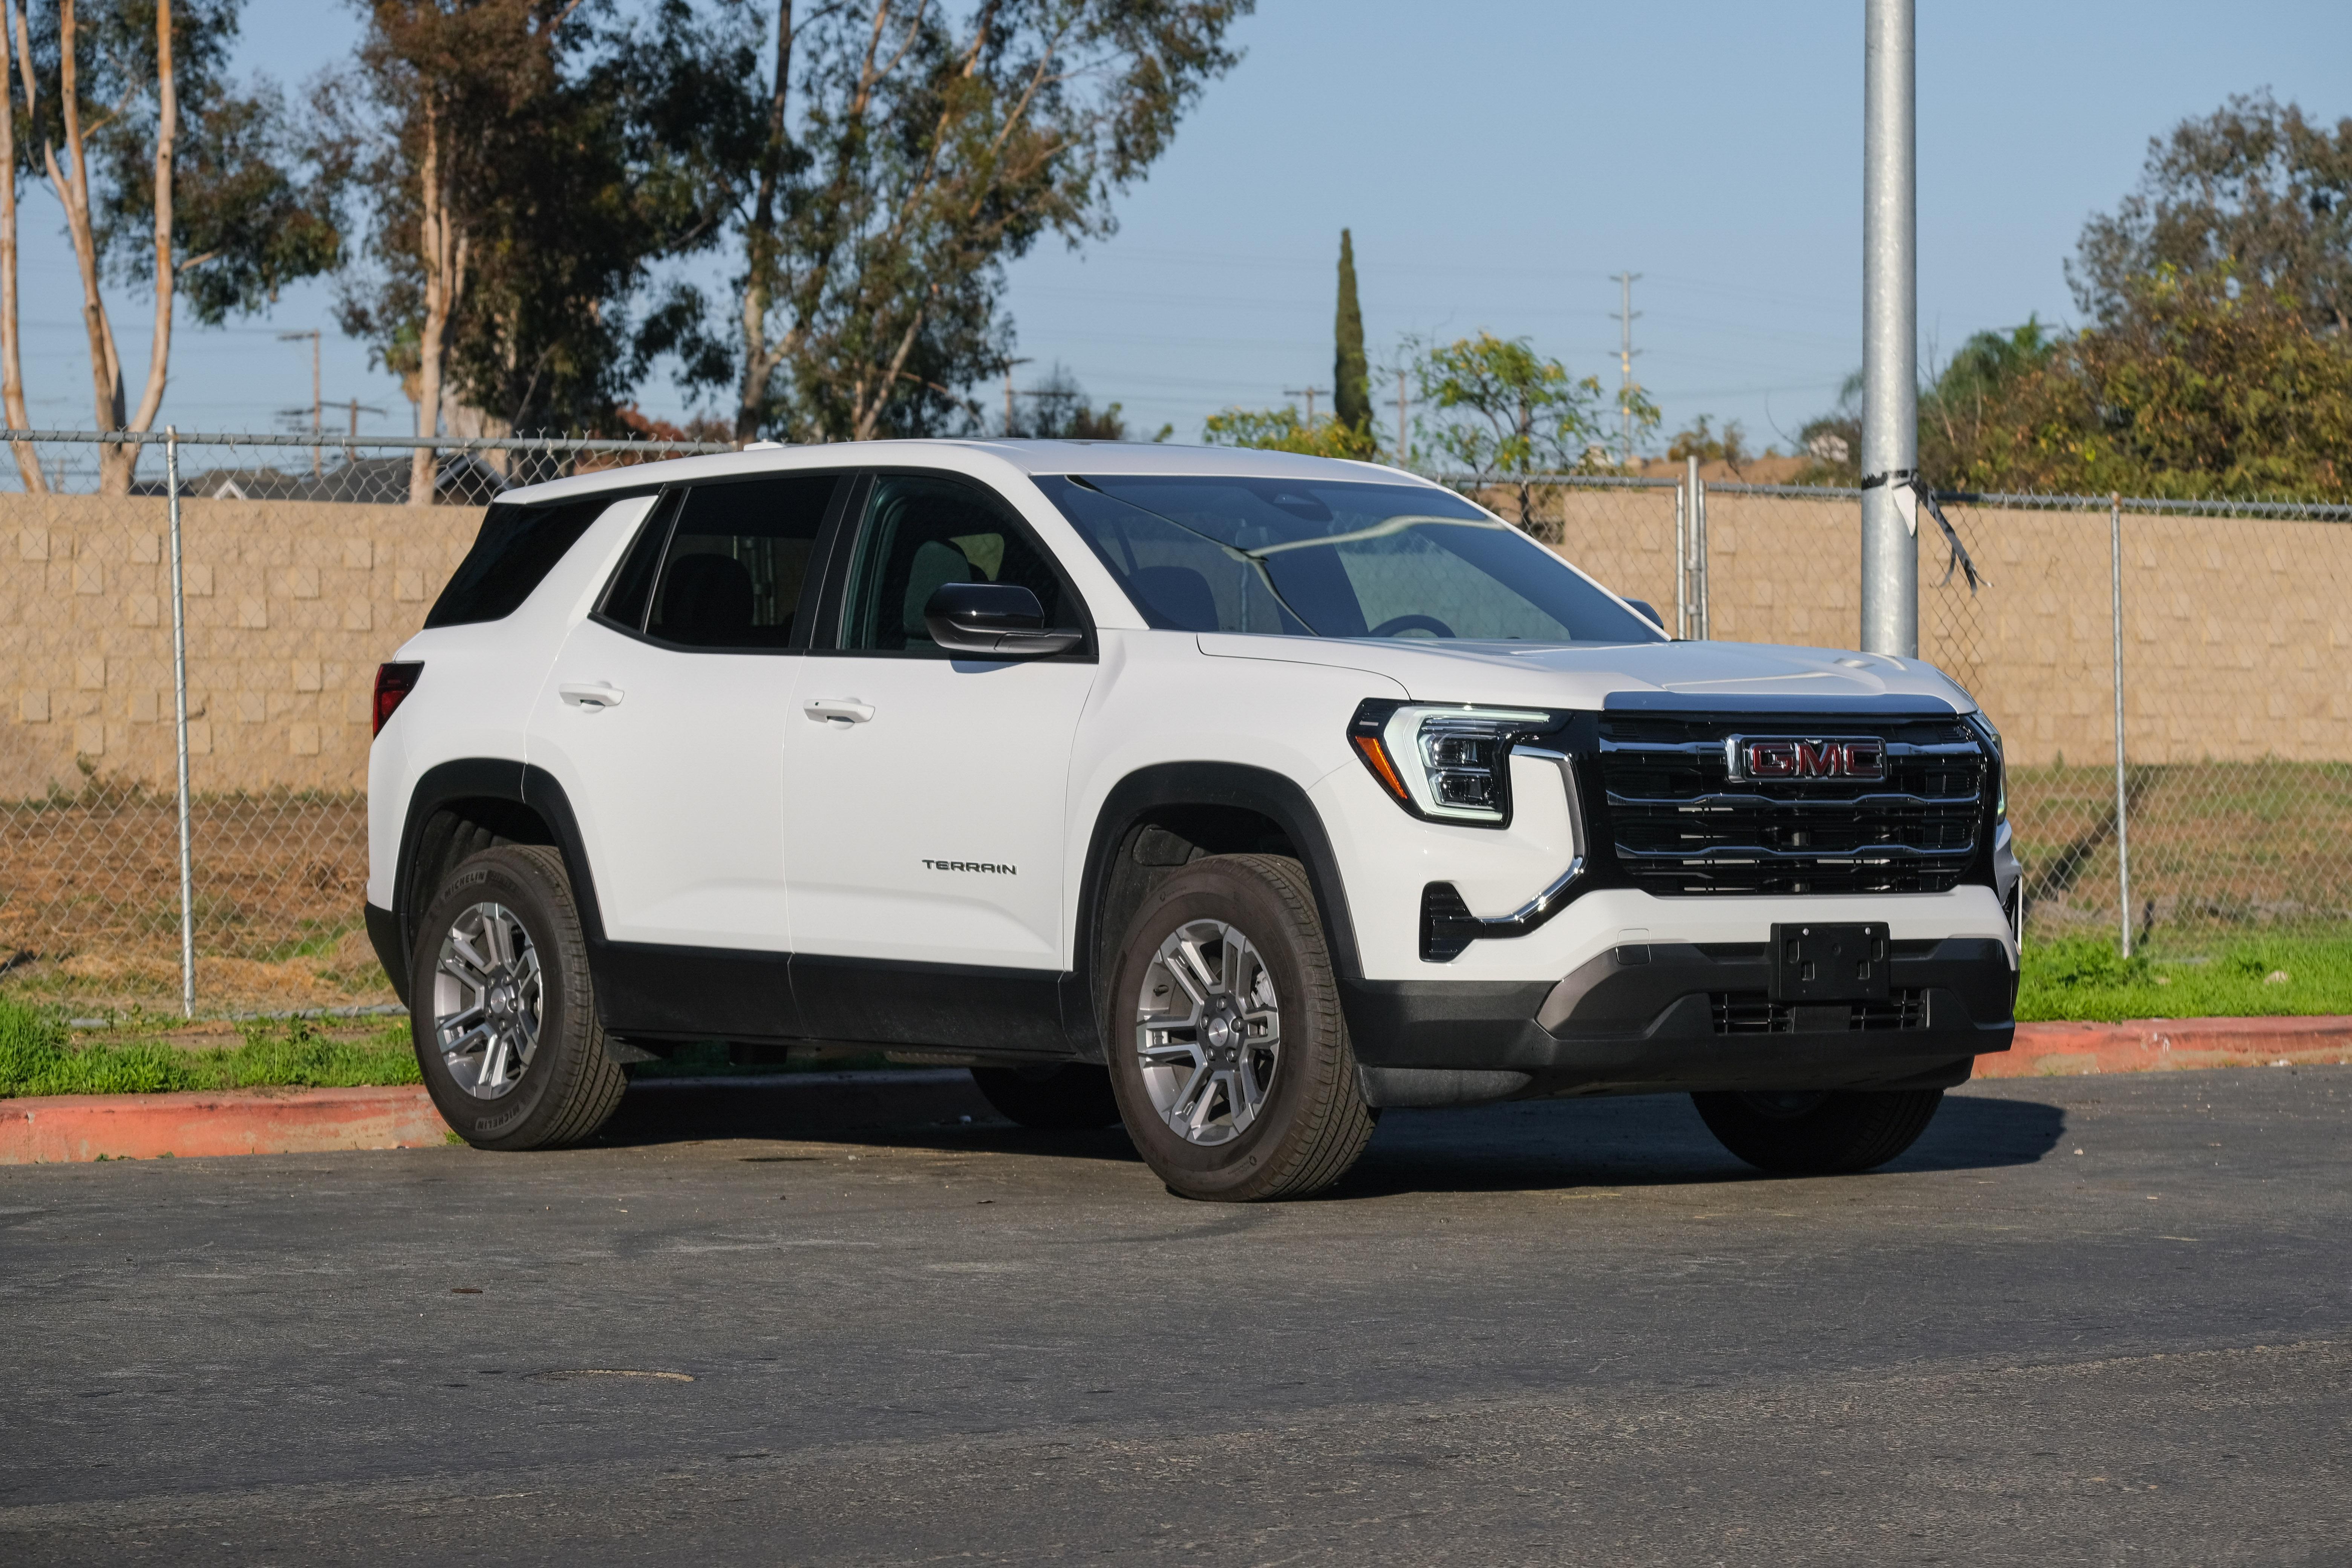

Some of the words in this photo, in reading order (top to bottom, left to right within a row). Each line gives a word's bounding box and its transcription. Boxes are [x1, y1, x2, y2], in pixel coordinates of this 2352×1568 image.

[1748, 742, 1882, 776] GMC
[922, 859, 1017, 875] TERRAIN
[444, 872, 485, 900] MICHELIN
[478, 1102, 520, 1129] MICHELIN
